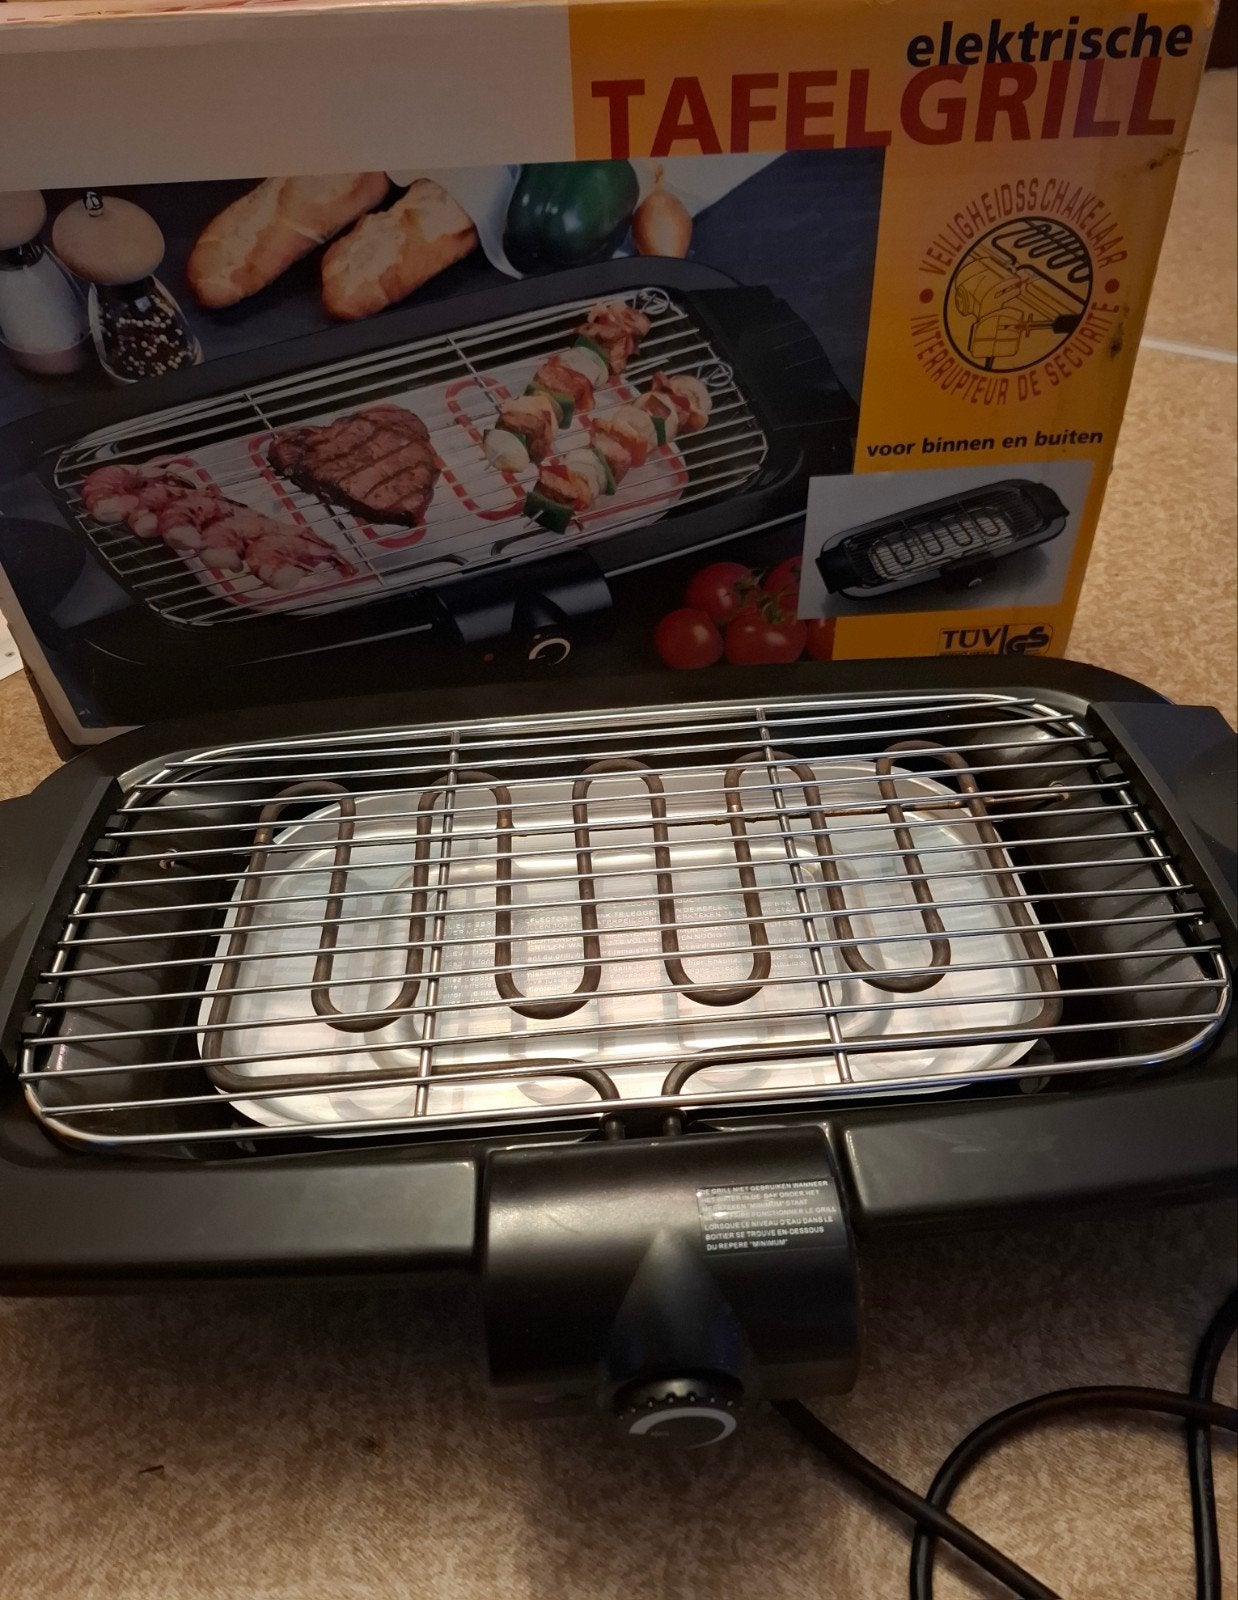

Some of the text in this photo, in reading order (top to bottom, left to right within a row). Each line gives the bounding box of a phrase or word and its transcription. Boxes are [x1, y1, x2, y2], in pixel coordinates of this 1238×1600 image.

[907, 13, 1193, 68] elektrische
[592, 56, 1178, 158] TAFELGRILL
[918, 177, 1128, 276] VEILIGHEIDSSCHAKELAAR
[910, 313, 1008, 406] INTERRUPTEUR
[1017, 370, 1042, 402] DE
[867, 429, 1103, 458] voor binnen en buiten
